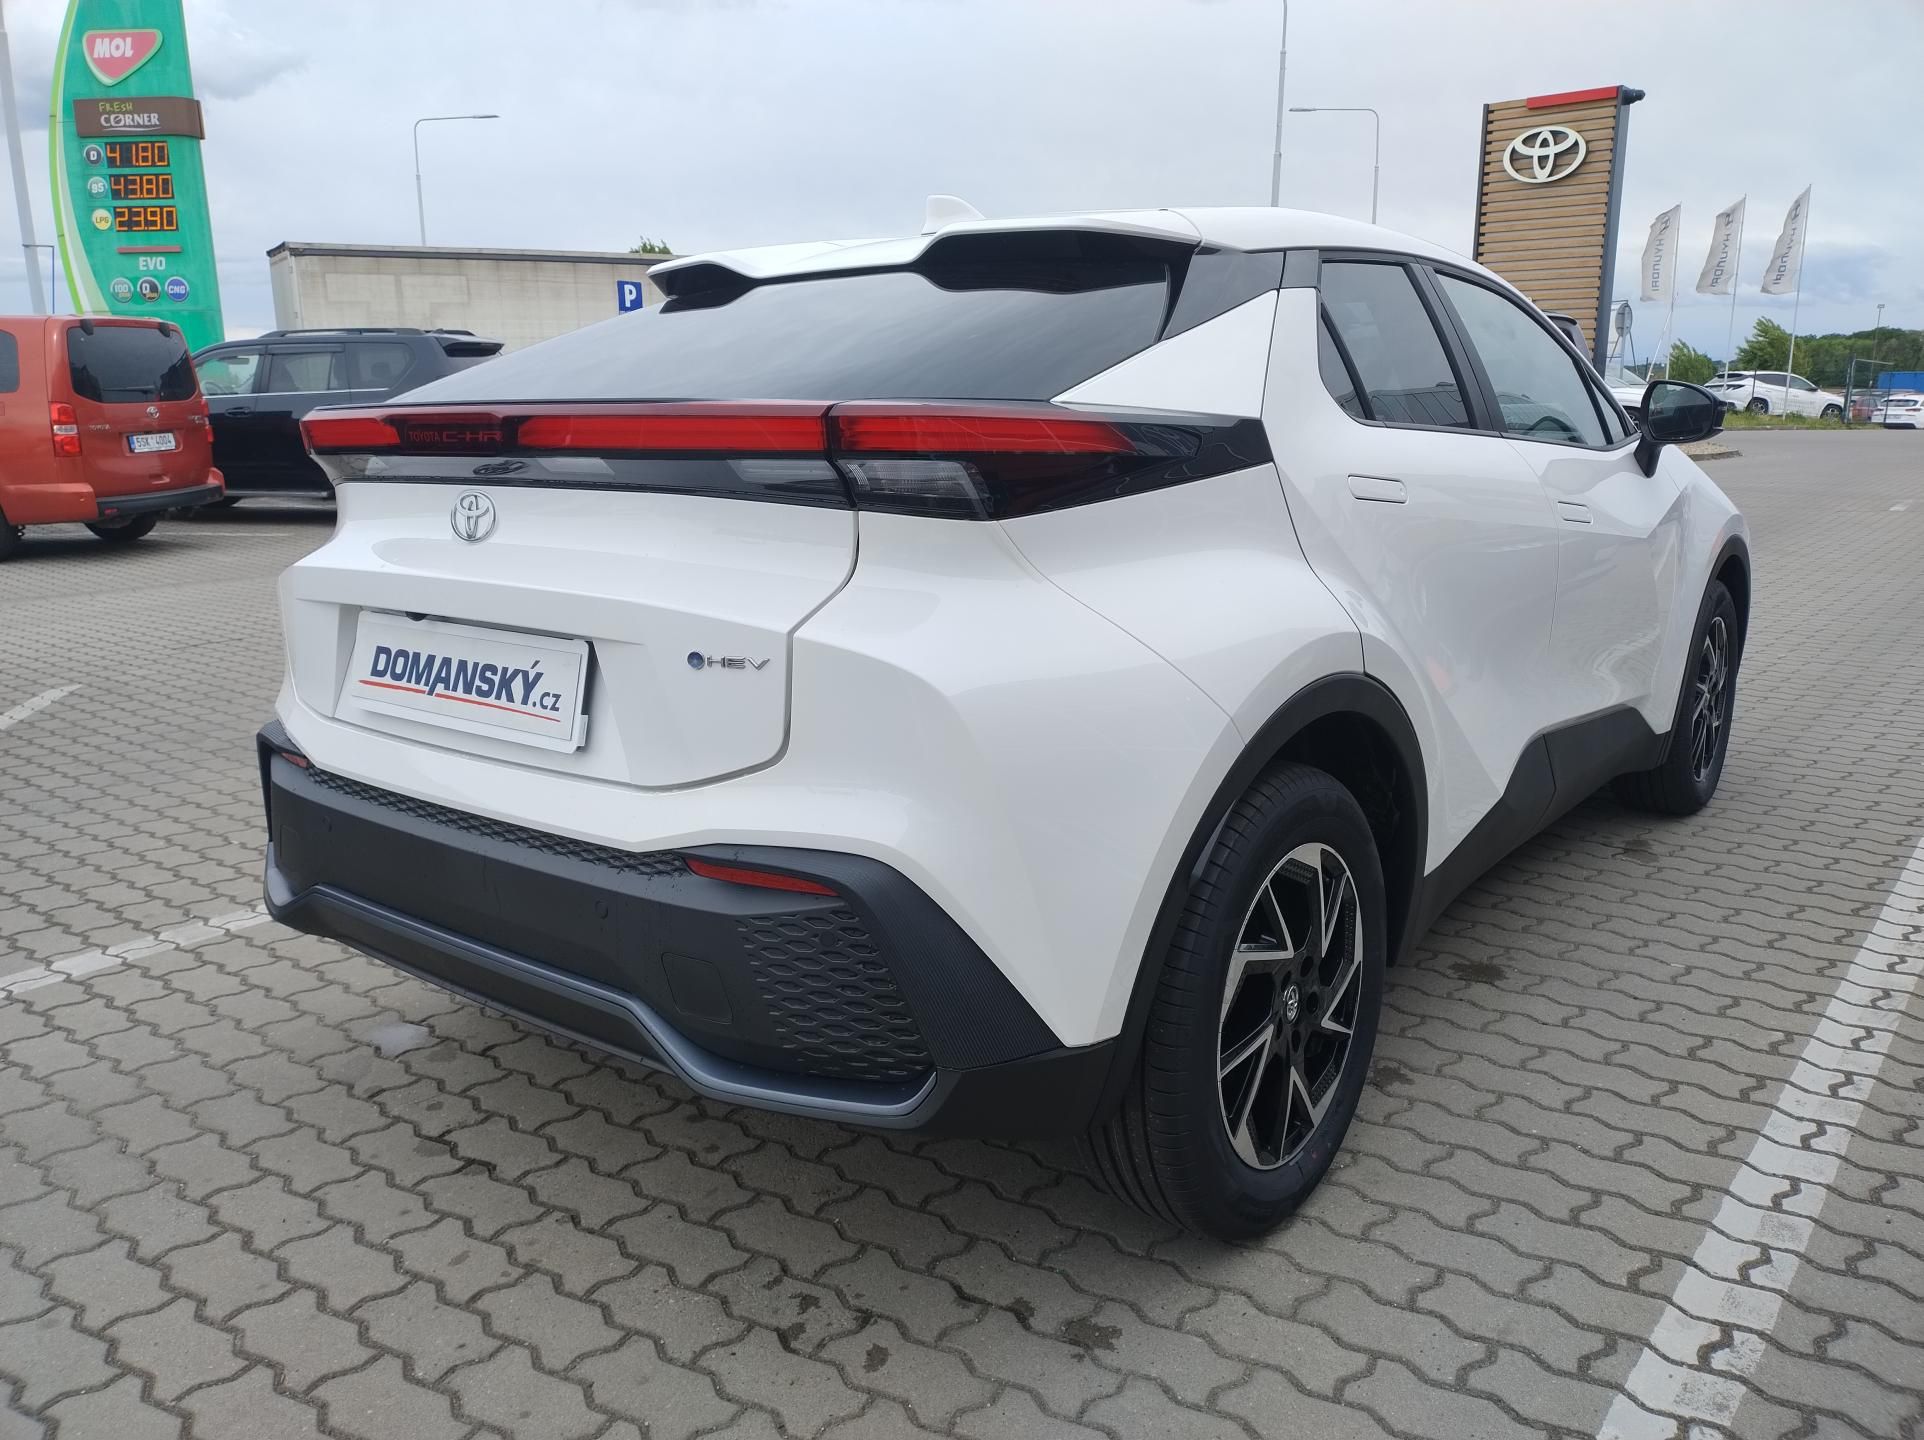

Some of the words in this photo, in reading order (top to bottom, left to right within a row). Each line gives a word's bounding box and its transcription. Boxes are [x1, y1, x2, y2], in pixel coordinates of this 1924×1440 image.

[93, 37, 134, 58] MOL
[100, 113, 160, 127] CORNER
[90, 151, 97, 161] D
[91, 183, 104, 193] 95
[95, 215, 109, 224] LPG
[138, 256, 166, 271] EVO
[168, 285, 186, 294] CNG
[624, 284, 637, 307] P
[408, 431, 440, 442] TOYOTA
[442, 431, 503, 443] C-HR
[706, 655, 770, 671] HEV
